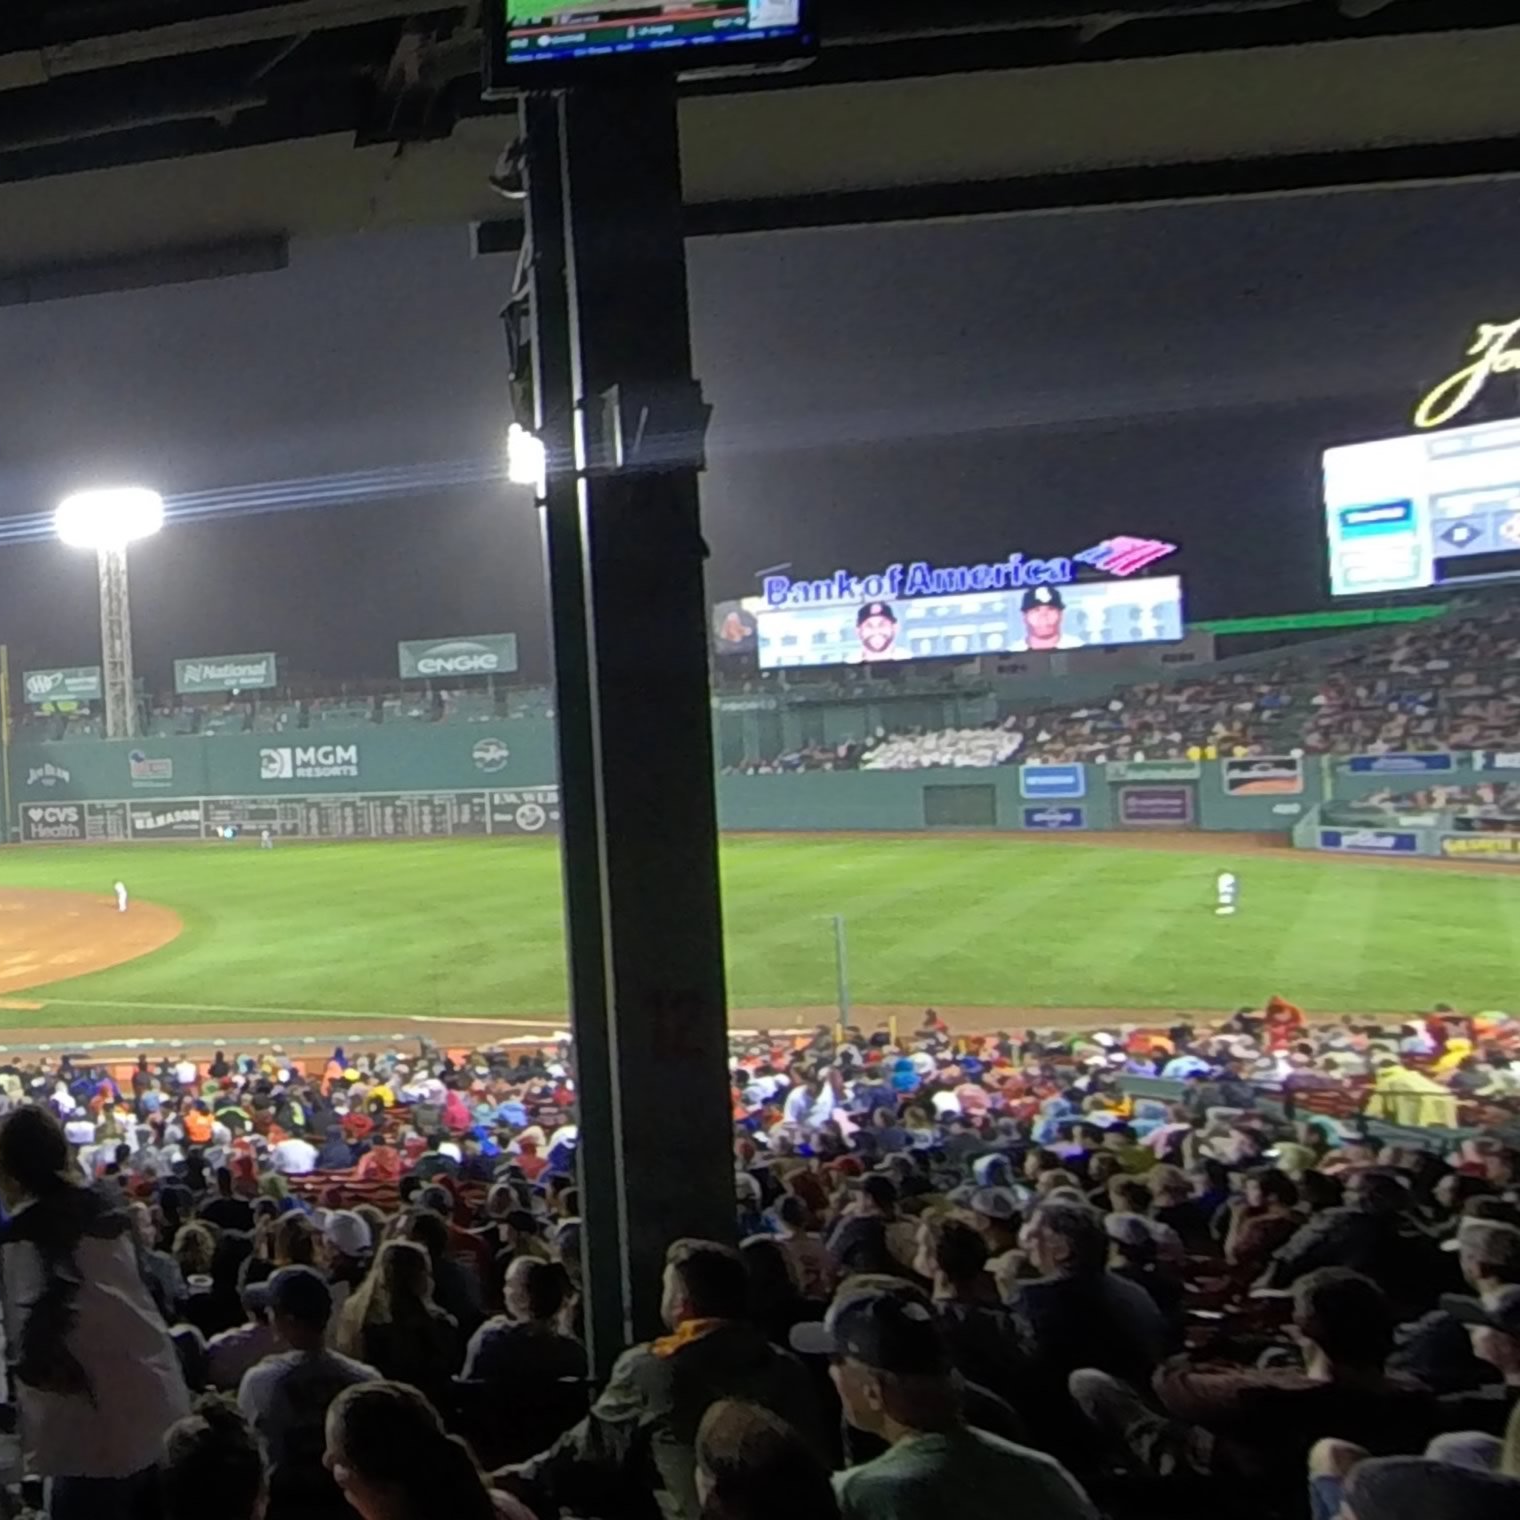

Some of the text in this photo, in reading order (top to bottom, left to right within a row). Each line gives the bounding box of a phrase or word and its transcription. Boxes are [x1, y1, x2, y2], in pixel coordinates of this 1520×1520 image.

[764, 552, 1074, 607] Bank of America
[202, 660, 267, 679] National
[295, 744, 358, 767] MGM
[44, 806, 80, 822] CVS
[30, 822, 80, 838] Health
